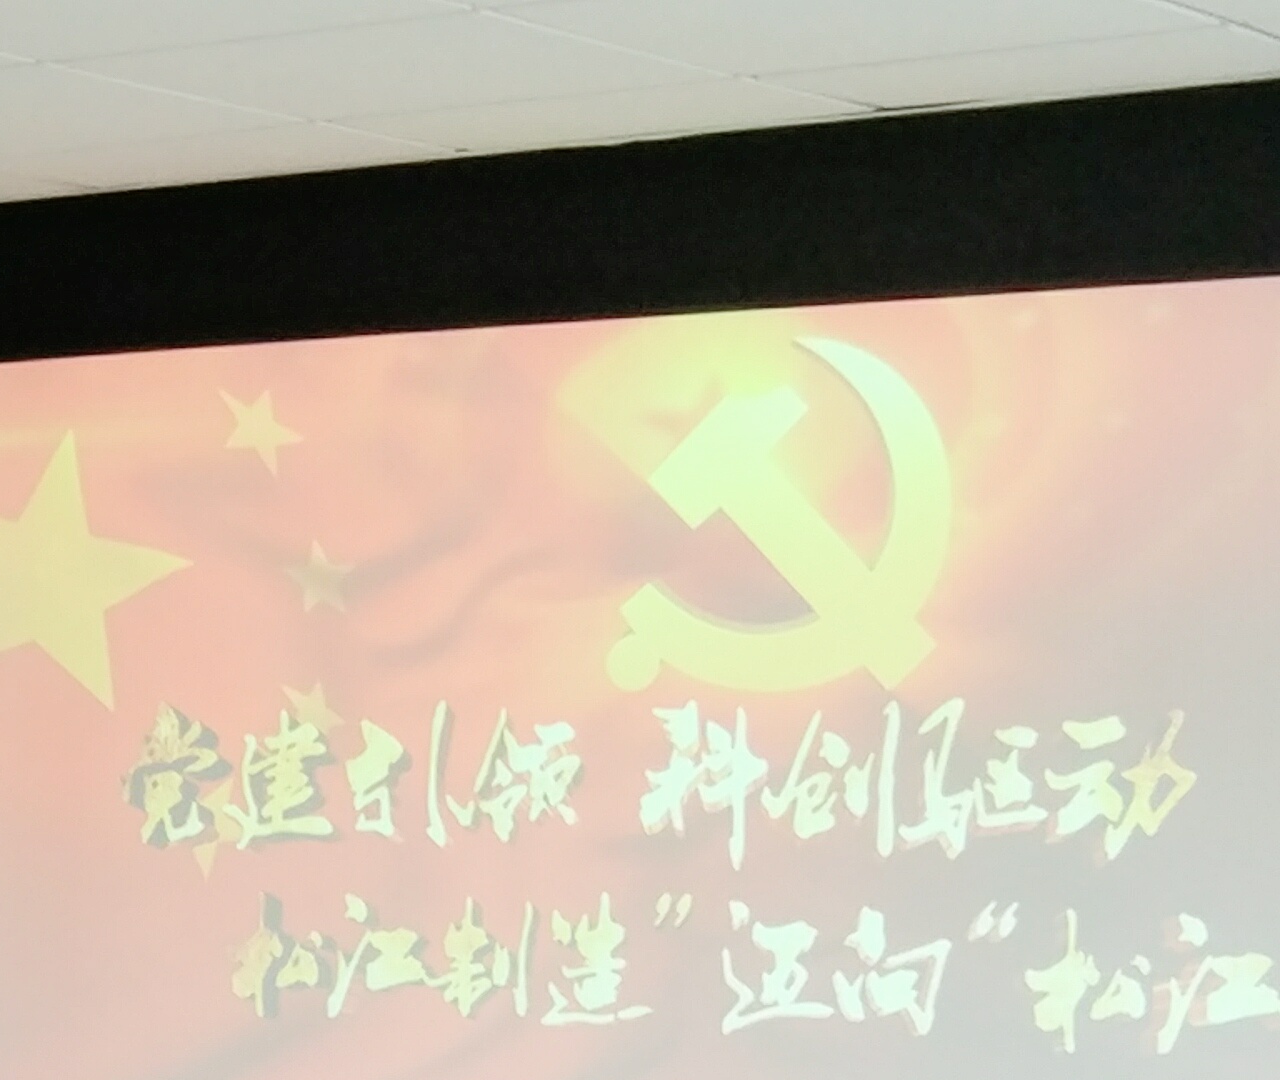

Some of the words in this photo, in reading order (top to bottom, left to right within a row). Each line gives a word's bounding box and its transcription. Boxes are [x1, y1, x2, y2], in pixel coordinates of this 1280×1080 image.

[124, 699, 583, 849] 党建引领
[639, 697, 1198, 871] 科创驱动
